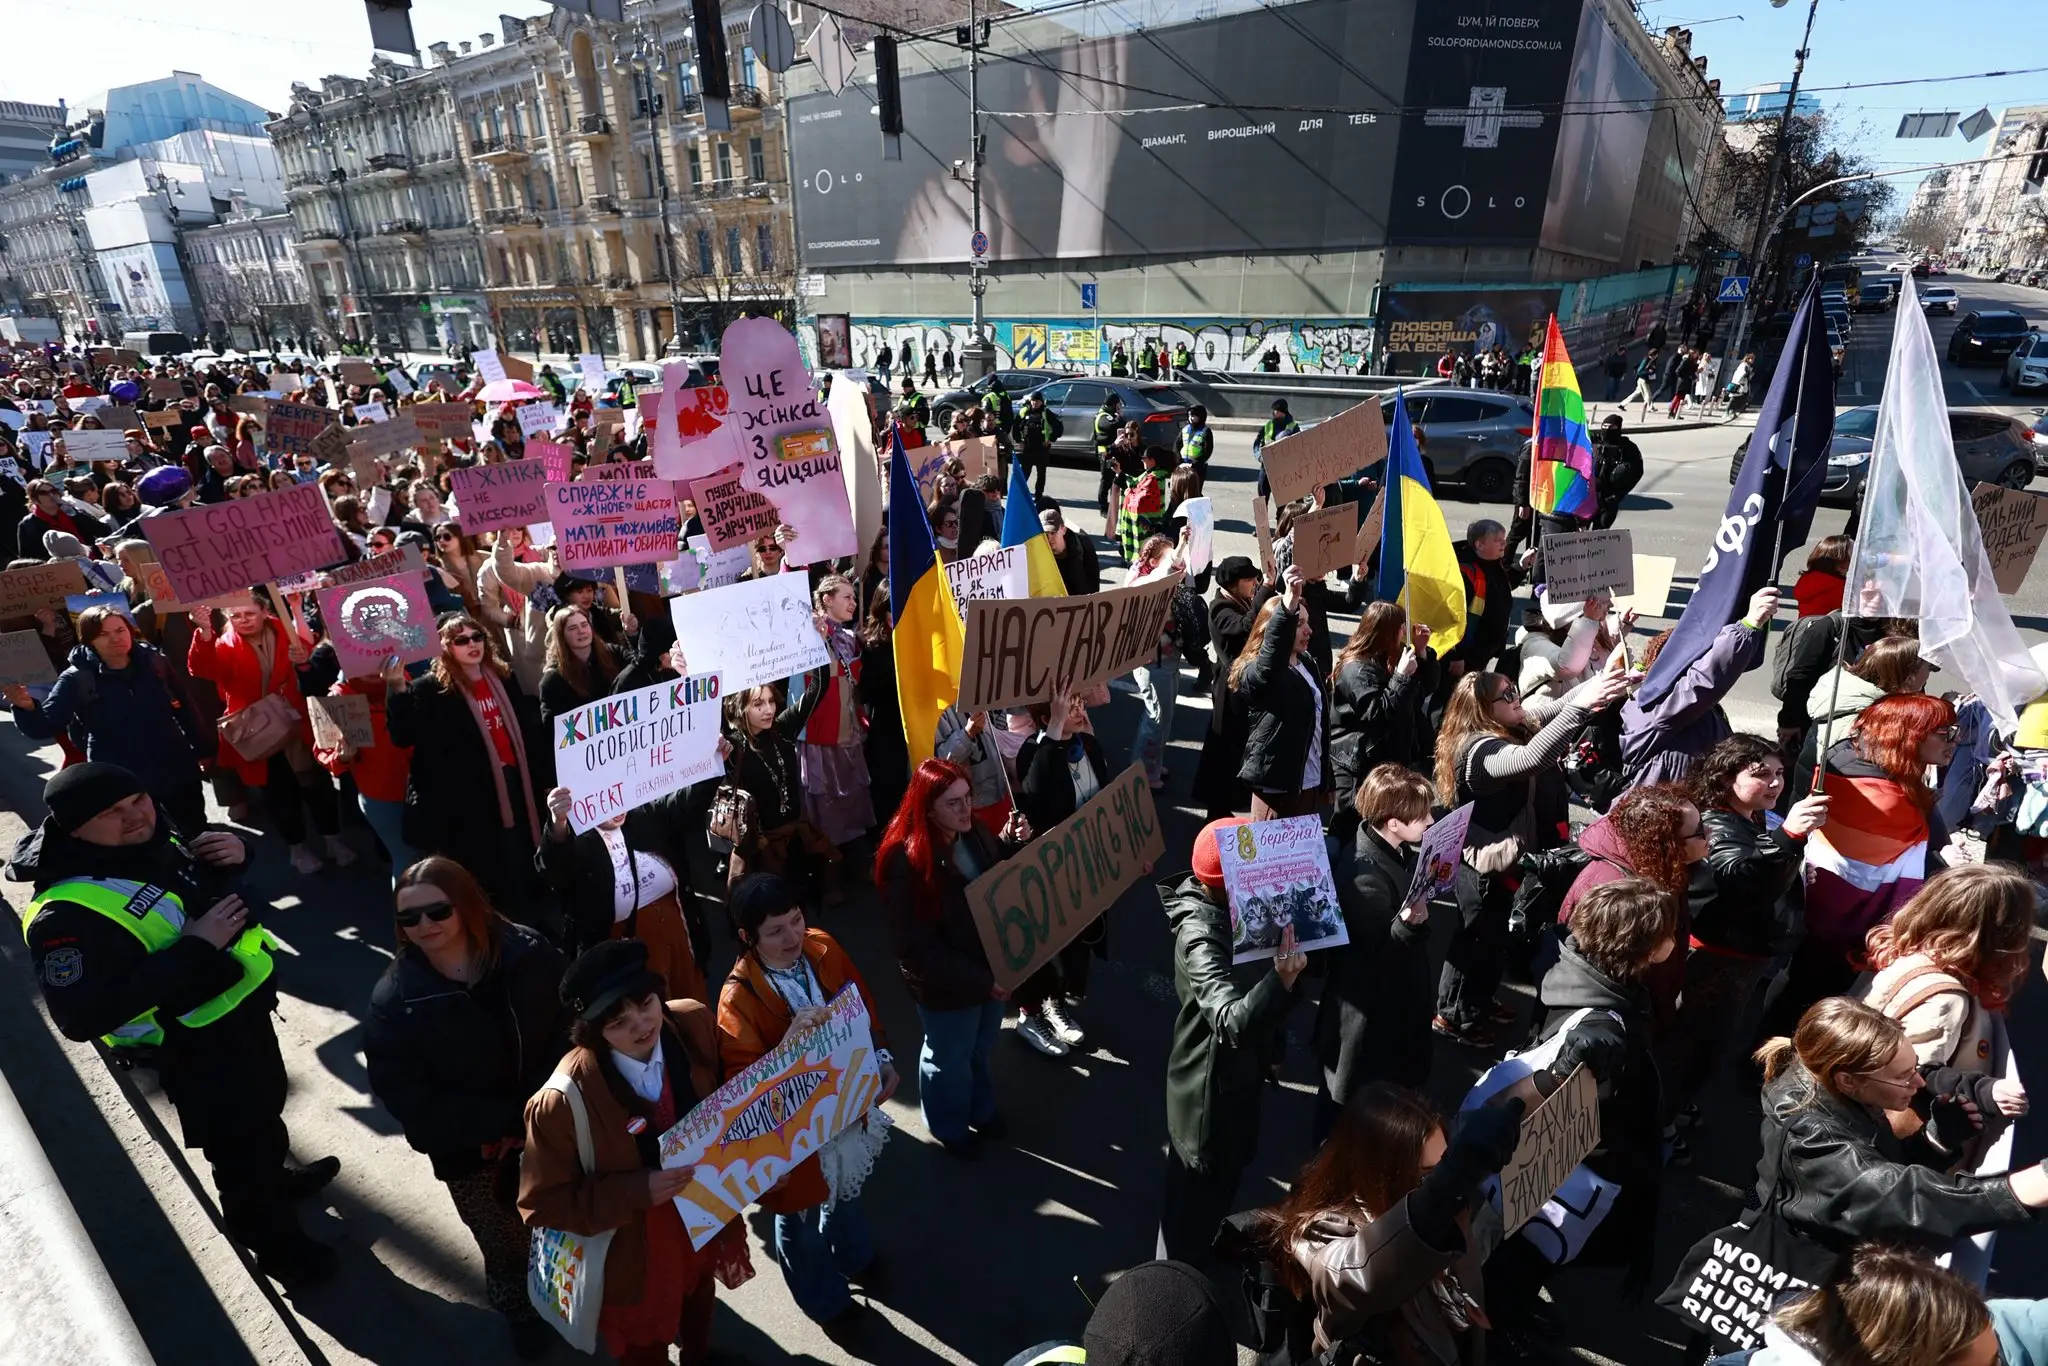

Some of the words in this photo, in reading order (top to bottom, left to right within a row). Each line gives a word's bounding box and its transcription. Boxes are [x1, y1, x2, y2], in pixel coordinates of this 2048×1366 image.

[1457, 16, 1483, 28] ЦУМ,
[1498, 17, 1540, 29] ПОВЕРХ
[1427, 36, 1562, 51] SOLOFORDIAMONDS.COM.UA
[1141, 133, 1187, 149] ДІАМАНТ,
[1207, 122, 1276, 140] ВИРОЩЕНИЙ
[1299, 118, 1323, 132] ДЛЯ
[1348, 113, 1377, 125] ТЕБЕ
[1389, 331, 1479, 343] СИЛЬНІША
[1390, 320, 1453, 332] ЛЮБОВ
[1388, 342, 1411, 353] ЗА
[1414, 342, 1447, 353] ВСЕ
[745, 374, 784, 402] ЦЕ
[476, 463, 547, 489] ЖІНКА
[558, 484, 648, 504] СПРАВЖНЄ
[175, 517, 197, 542] I
[205, 505, 246, 535] GO
[256, 486, 319, 520] HARD
[472, 491, 491, 504] НЕ
[162, 540, 206, 574] GET
[283, 510, 331, 544] MINE
[565, 525, 606, 542] МАТИ
[975, 600, 1113, 705] НАСТАВ
[559, 695, 639, 750] ЖІНКИ
[650, 690, 660, 715] В
[670, 675, 719, 710] КІНО
[626, 756, 638, 777] А
[650, 741, 674, 768] НЕ
[635, 771, 676, 799] БАЖАННЯ
[679, 757, 713, 781] ЧОЛОВІКА
[1237, 824, 1257, 861] 8
[1260, 820, 1320, 849] березня!
[128, 883, 165, 917] ПОЛІЦІ
[1518, 1074, 1584, 1170] ЗАХИСТ
[1712, 1237, 1822, 1291] WOM
[1700, 1257, 1774, 1312] RIGH
[1681, 1295, 1762, 1350] RIGH
